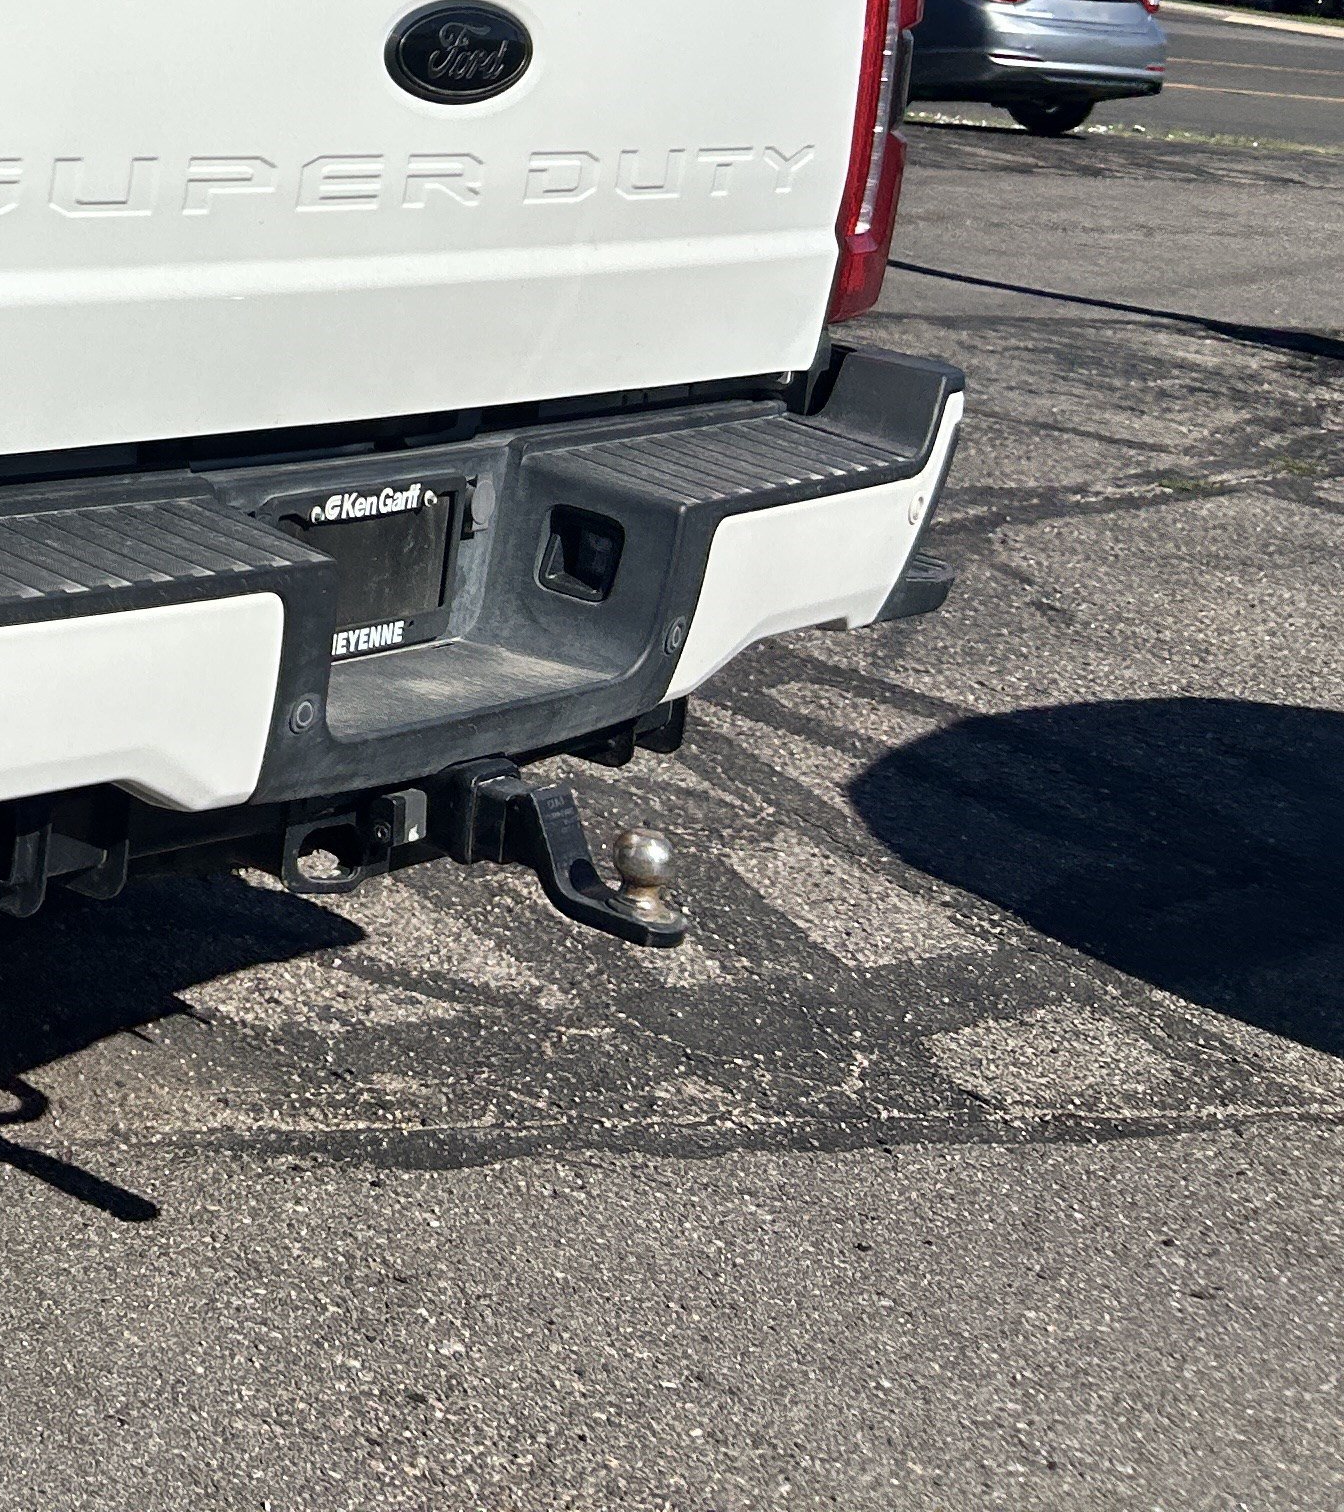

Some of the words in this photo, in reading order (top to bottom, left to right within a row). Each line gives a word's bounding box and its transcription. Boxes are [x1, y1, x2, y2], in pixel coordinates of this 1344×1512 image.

[427, 21, 509, 80] Ford
[523, 144, 816, 205] DUTY
[341, 492, 378, 520] Ken
